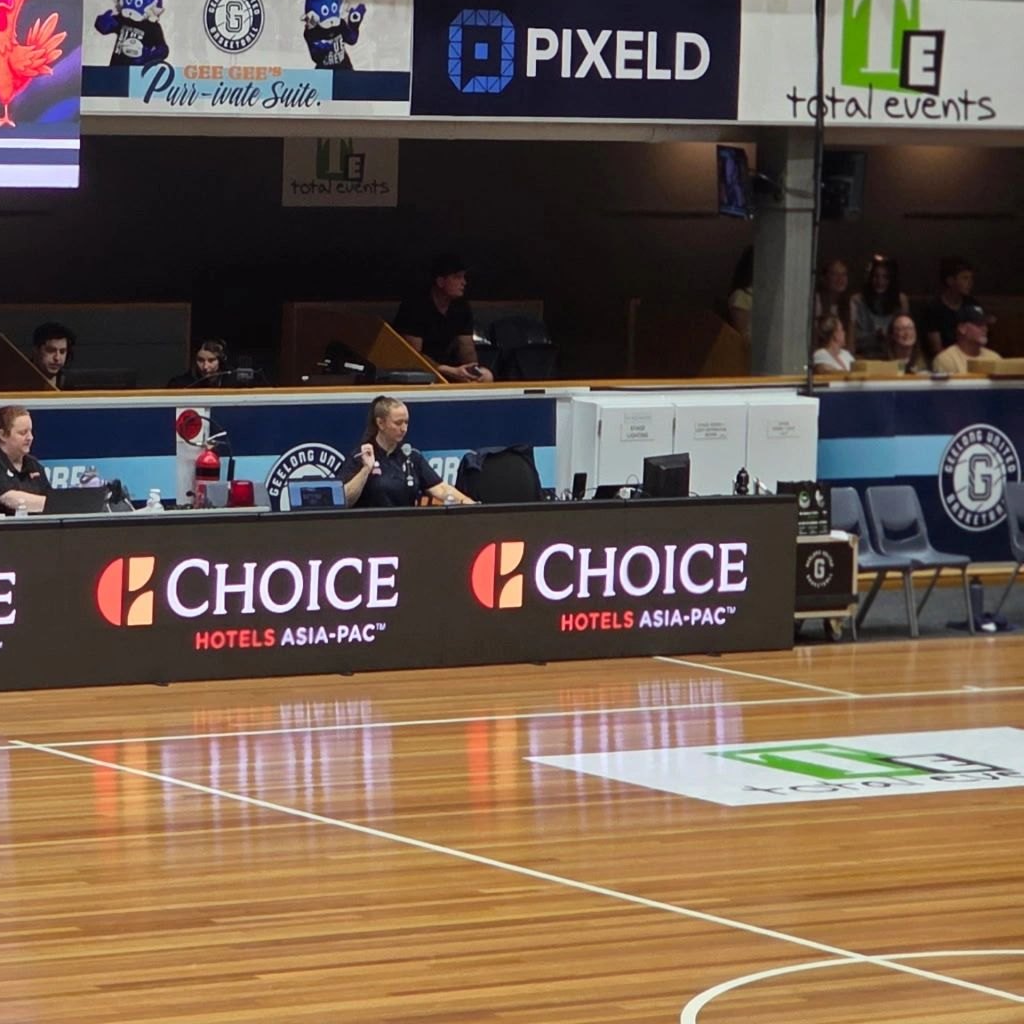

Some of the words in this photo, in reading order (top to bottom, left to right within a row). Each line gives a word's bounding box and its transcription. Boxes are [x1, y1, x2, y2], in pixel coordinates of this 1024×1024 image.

[183, 64, 224, 80] GEE
[526, 27, 711, 80] PIXELD
[141, 60, 261, 107] Purr-ivate
[786, 83, 873, 119] total
[884, 89, 996, 121] events
[269, 449, 314, 497] GEELONG
[945, 429, 982, 473] GEELONG
[986, 431, 1016, 473] UNITED
[166, 556, 399, 617] CHOICE
[534, 542, 748, 600] CHOICE
[195, 628, 276, 650] HOTELS
[561, 610, 634, 632] HOTELS
